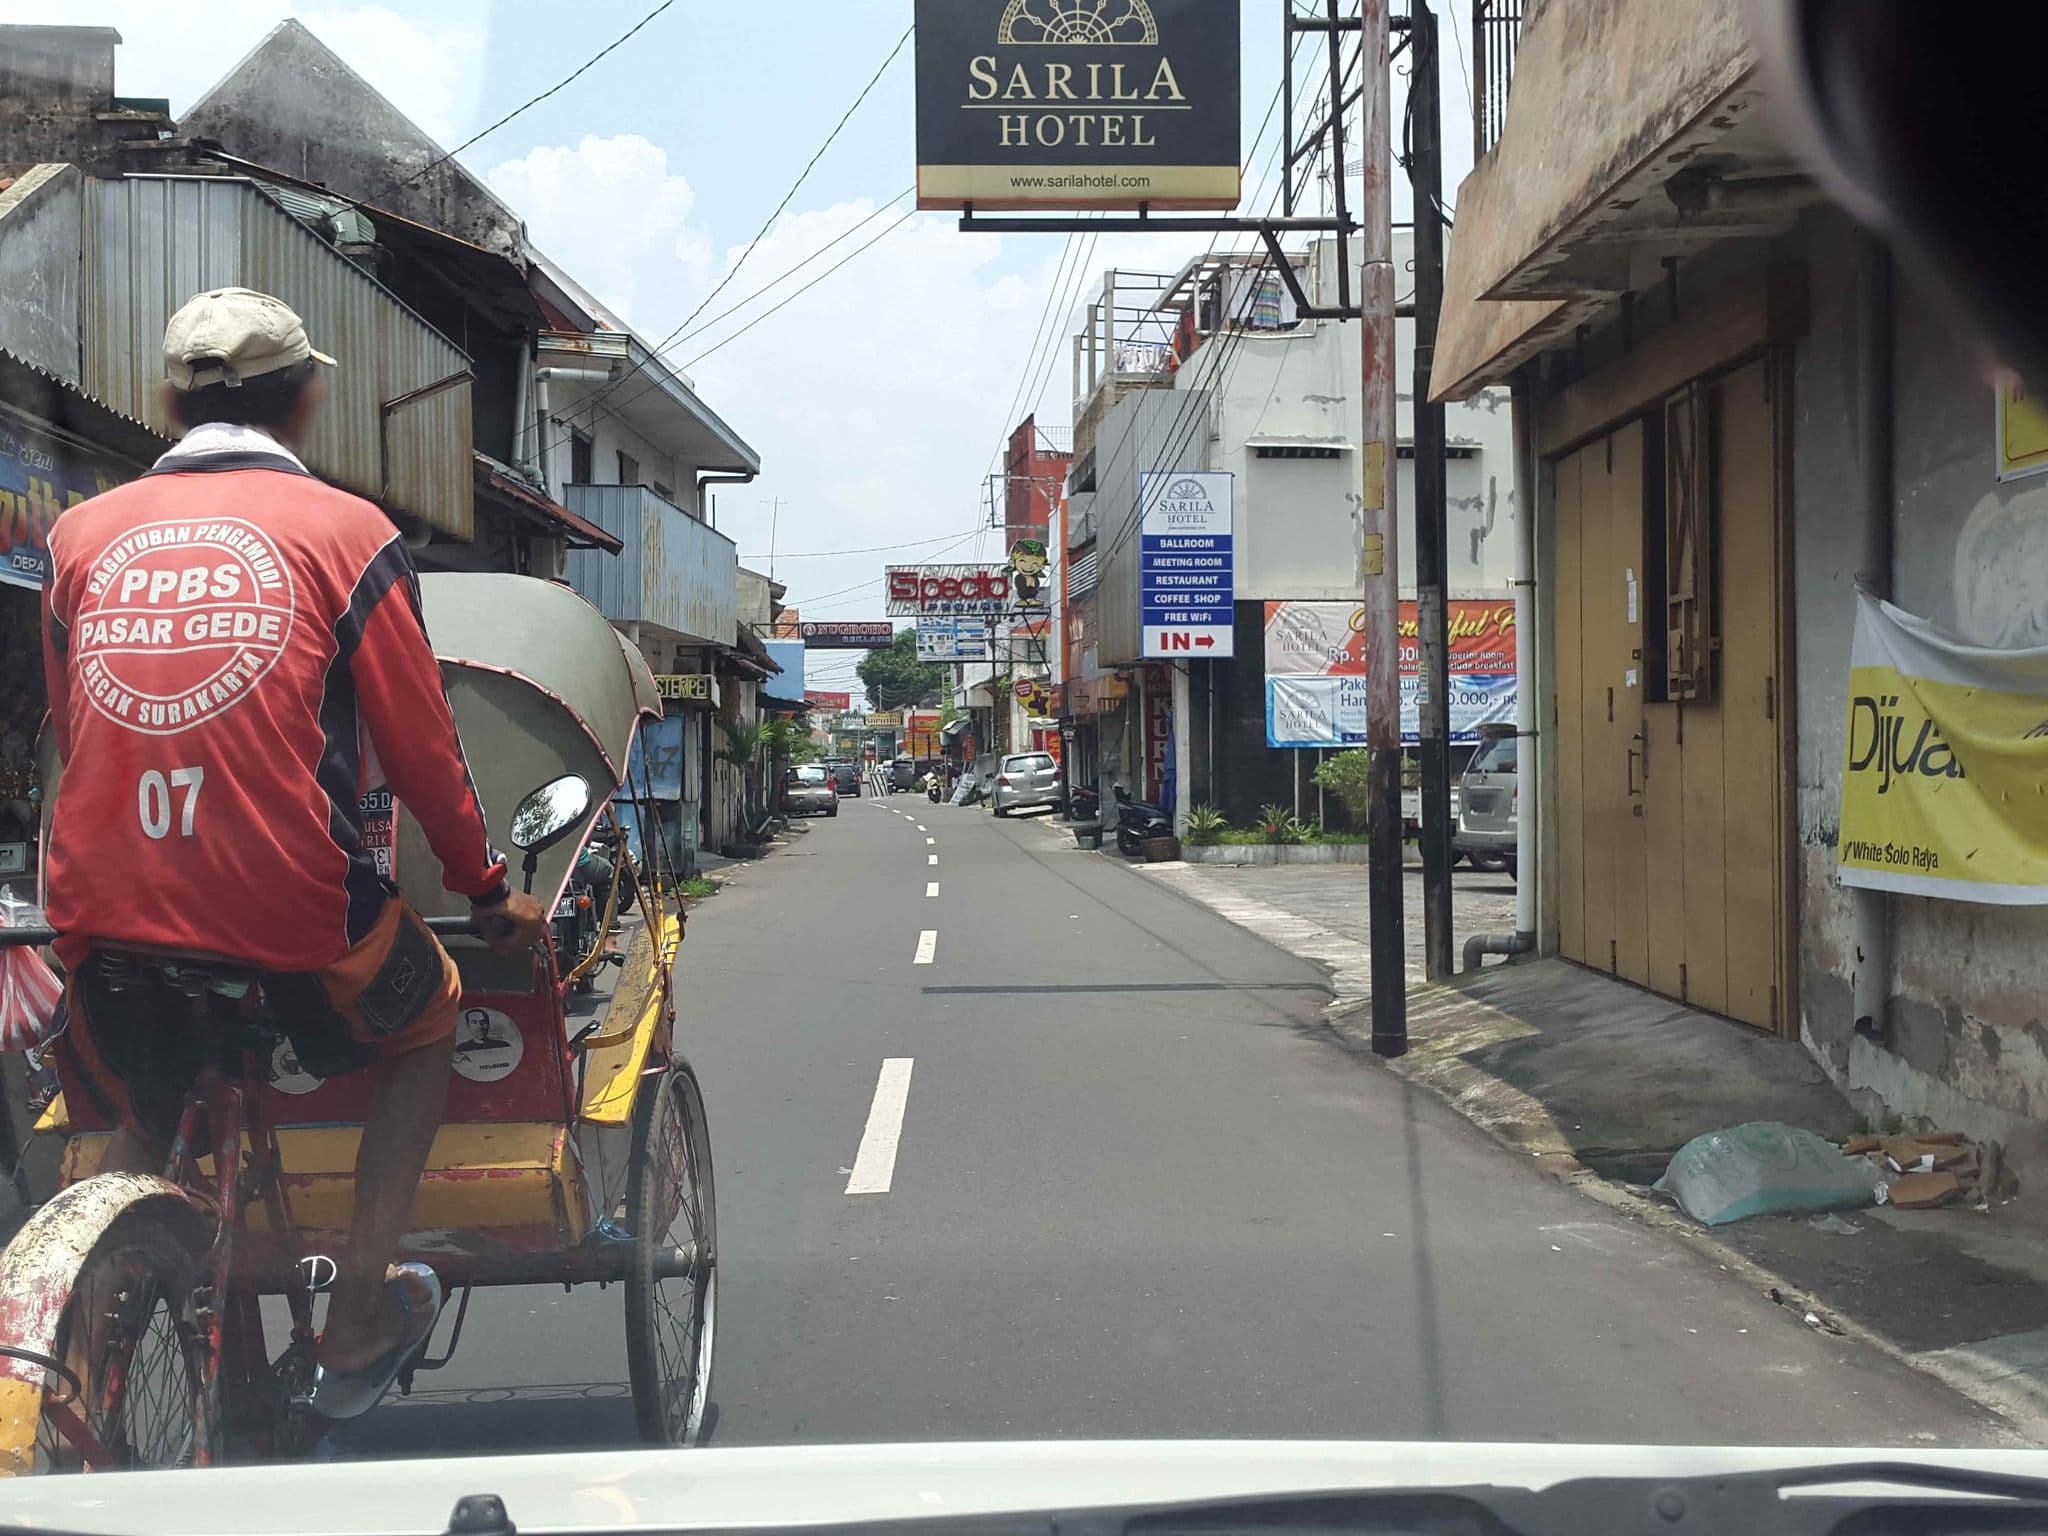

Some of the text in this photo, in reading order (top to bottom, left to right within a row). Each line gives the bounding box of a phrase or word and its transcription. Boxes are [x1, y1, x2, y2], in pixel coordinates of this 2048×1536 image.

[968, 55, 1186, 101] SARILA
[998, 115, 1156, 146] HOTEL
[1010, 174, 1150, 191] www.sarilahotel.com
[1159, 500, 1215, 512] SARILA
[1167, 514, 1207, 524] HOTEL
[1160, 539, 1214, 548] BALLROOM
[88, 524, 283, 595] PAGUYUBAN PENGEMUDI
[1153, 558, 1222, 567] MEETING ROOM
[119, 563, 241, 604] PPBS
[1156, 576, 1219, 585] RESTAURANT
[1154, 594, 1221, 604] COFFEE SHOP
[1164, 612, 1188, 622] FREE
[80, 611, 281, 649] PASAR GEDE
[1276, 630, 1328, 641] SARILA
[1160, 632, 1191, 651] IN
[1282, 642, 1321, 652] HOTEL
[1327, 646, 1355, 664] Rp.
[1475, 661, 1515, 670] breakfast
[85, 652, 265, 726] BECAK SURAKARTA
[656, 678, 708, 697] STEMPEL
[1279, 710, 1327, 721] SARILA
[1285, 720, 1321, 729] HOTEL
[139, 766, 204, 839] 07
[1853, 841, 1883, 863] White
[1885, 842, 1910, 866] Solo
[1912, 846, 1939, 872] Raya
